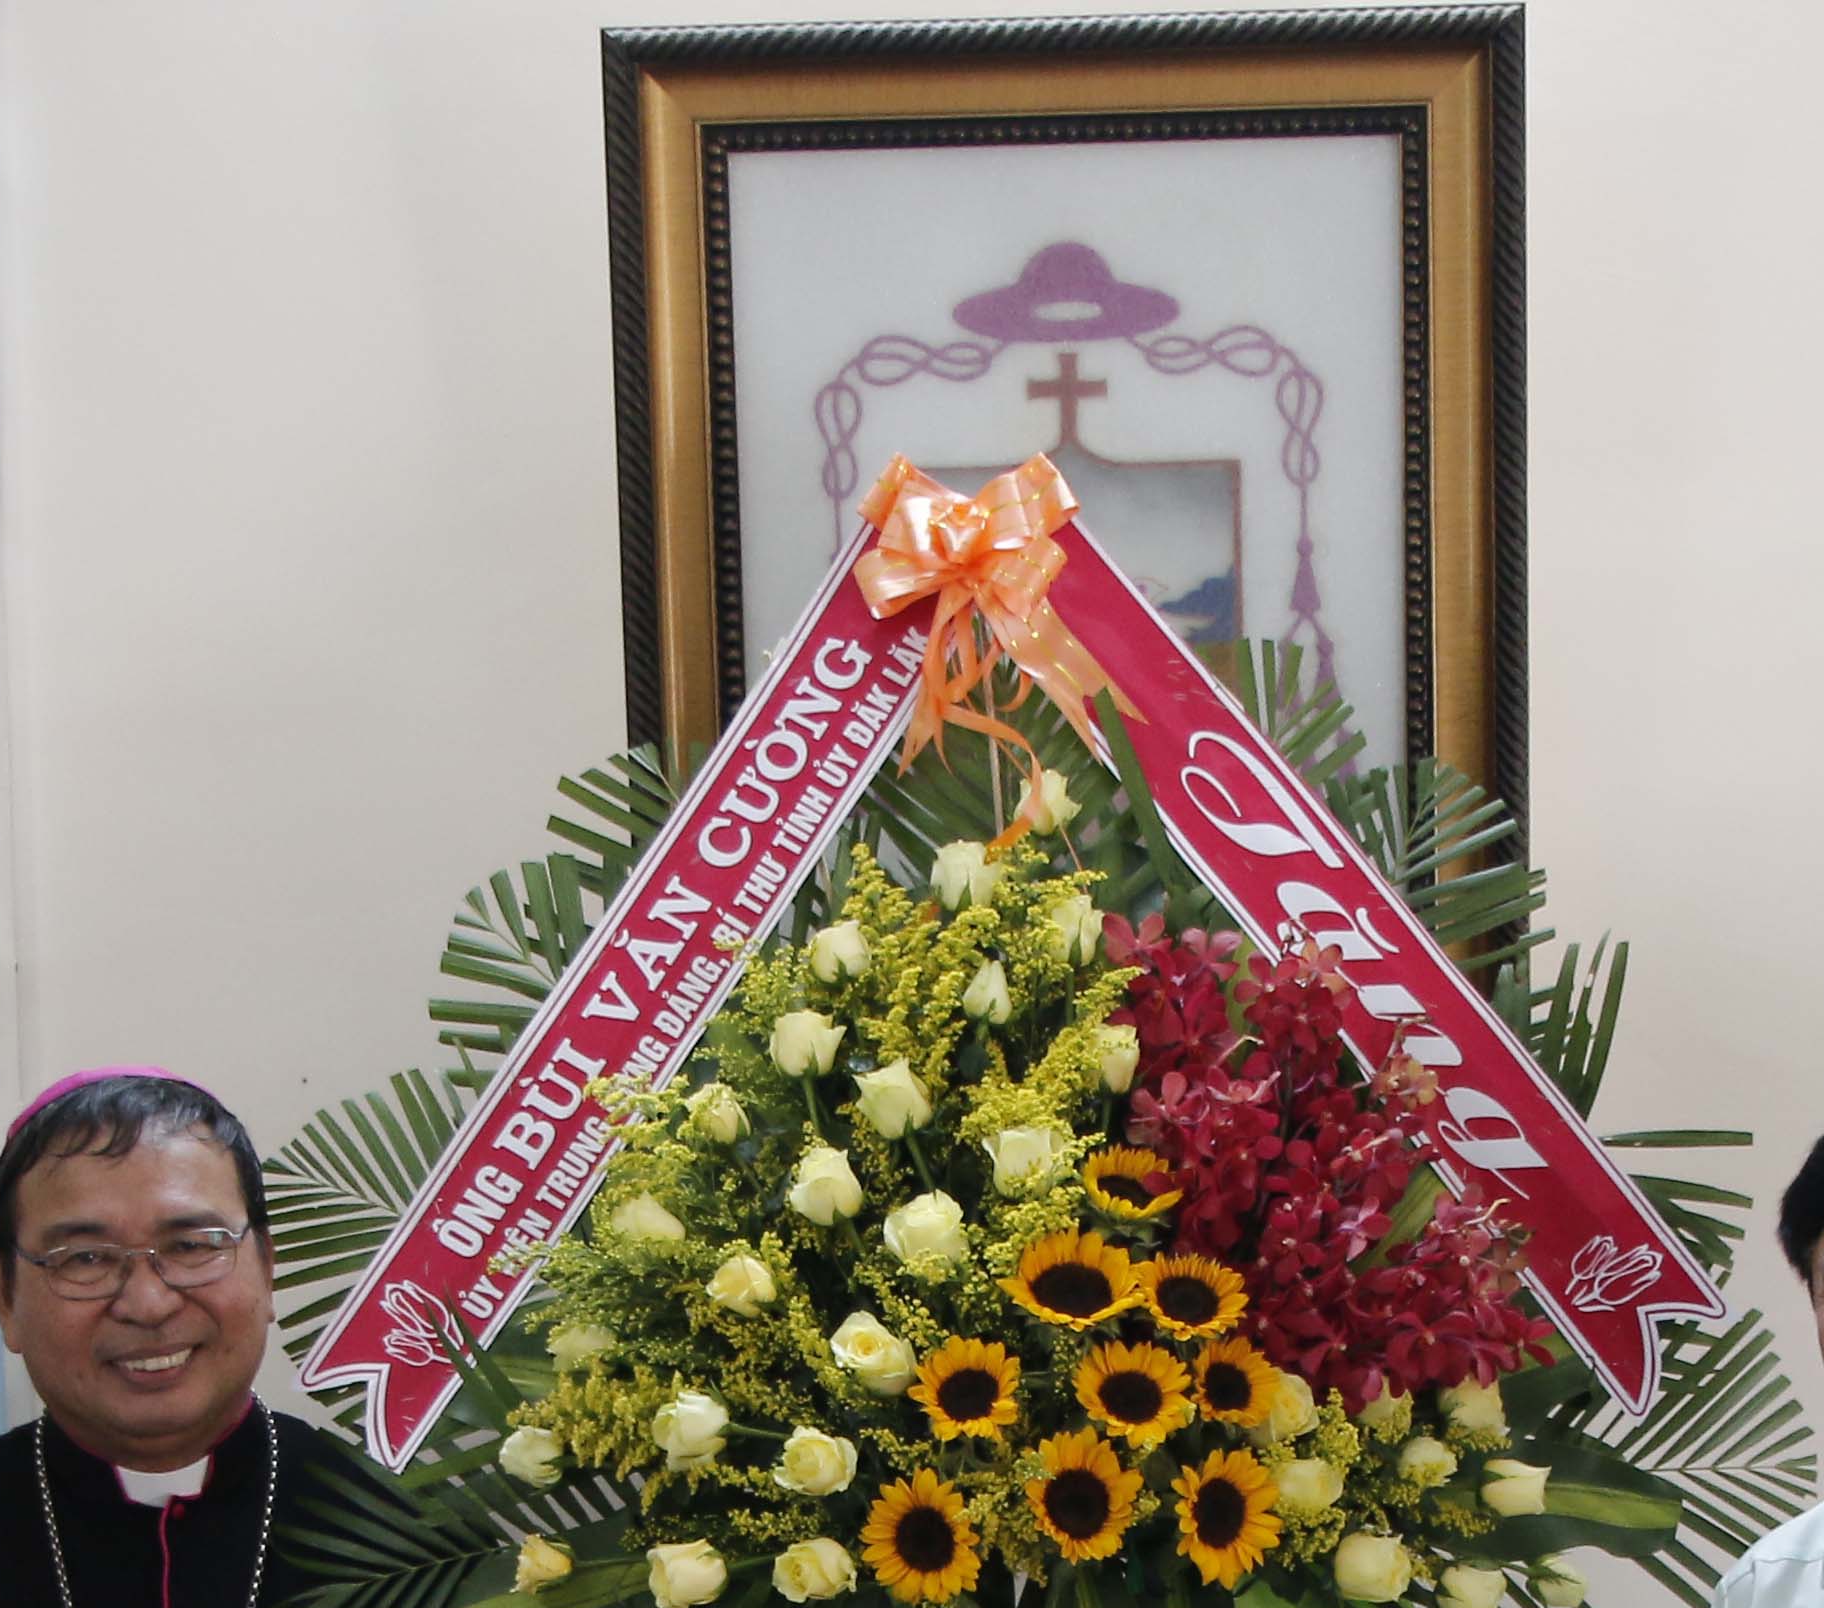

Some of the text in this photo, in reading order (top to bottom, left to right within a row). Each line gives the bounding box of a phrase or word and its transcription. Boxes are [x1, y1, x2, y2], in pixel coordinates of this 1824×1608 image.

[431, 637, 873, 1259] ÔNG BÙI VĂN CƯỜNG
[458, 1274, 505, 1320] ỦY
[535, 1114, 614, 1211] TRUNG
[653, 955, 730, 1039] ĐẢNG,
[710, 908, 753, 951] BÍ
[733, 851, 787, 915] THƯ
[772, 785, 834, 855] TỈNH
[812, 743, 859, 788] ỦY
[843, 683, 899, 749] ĐĂK
[881, 626, 929, 688] LĂK
